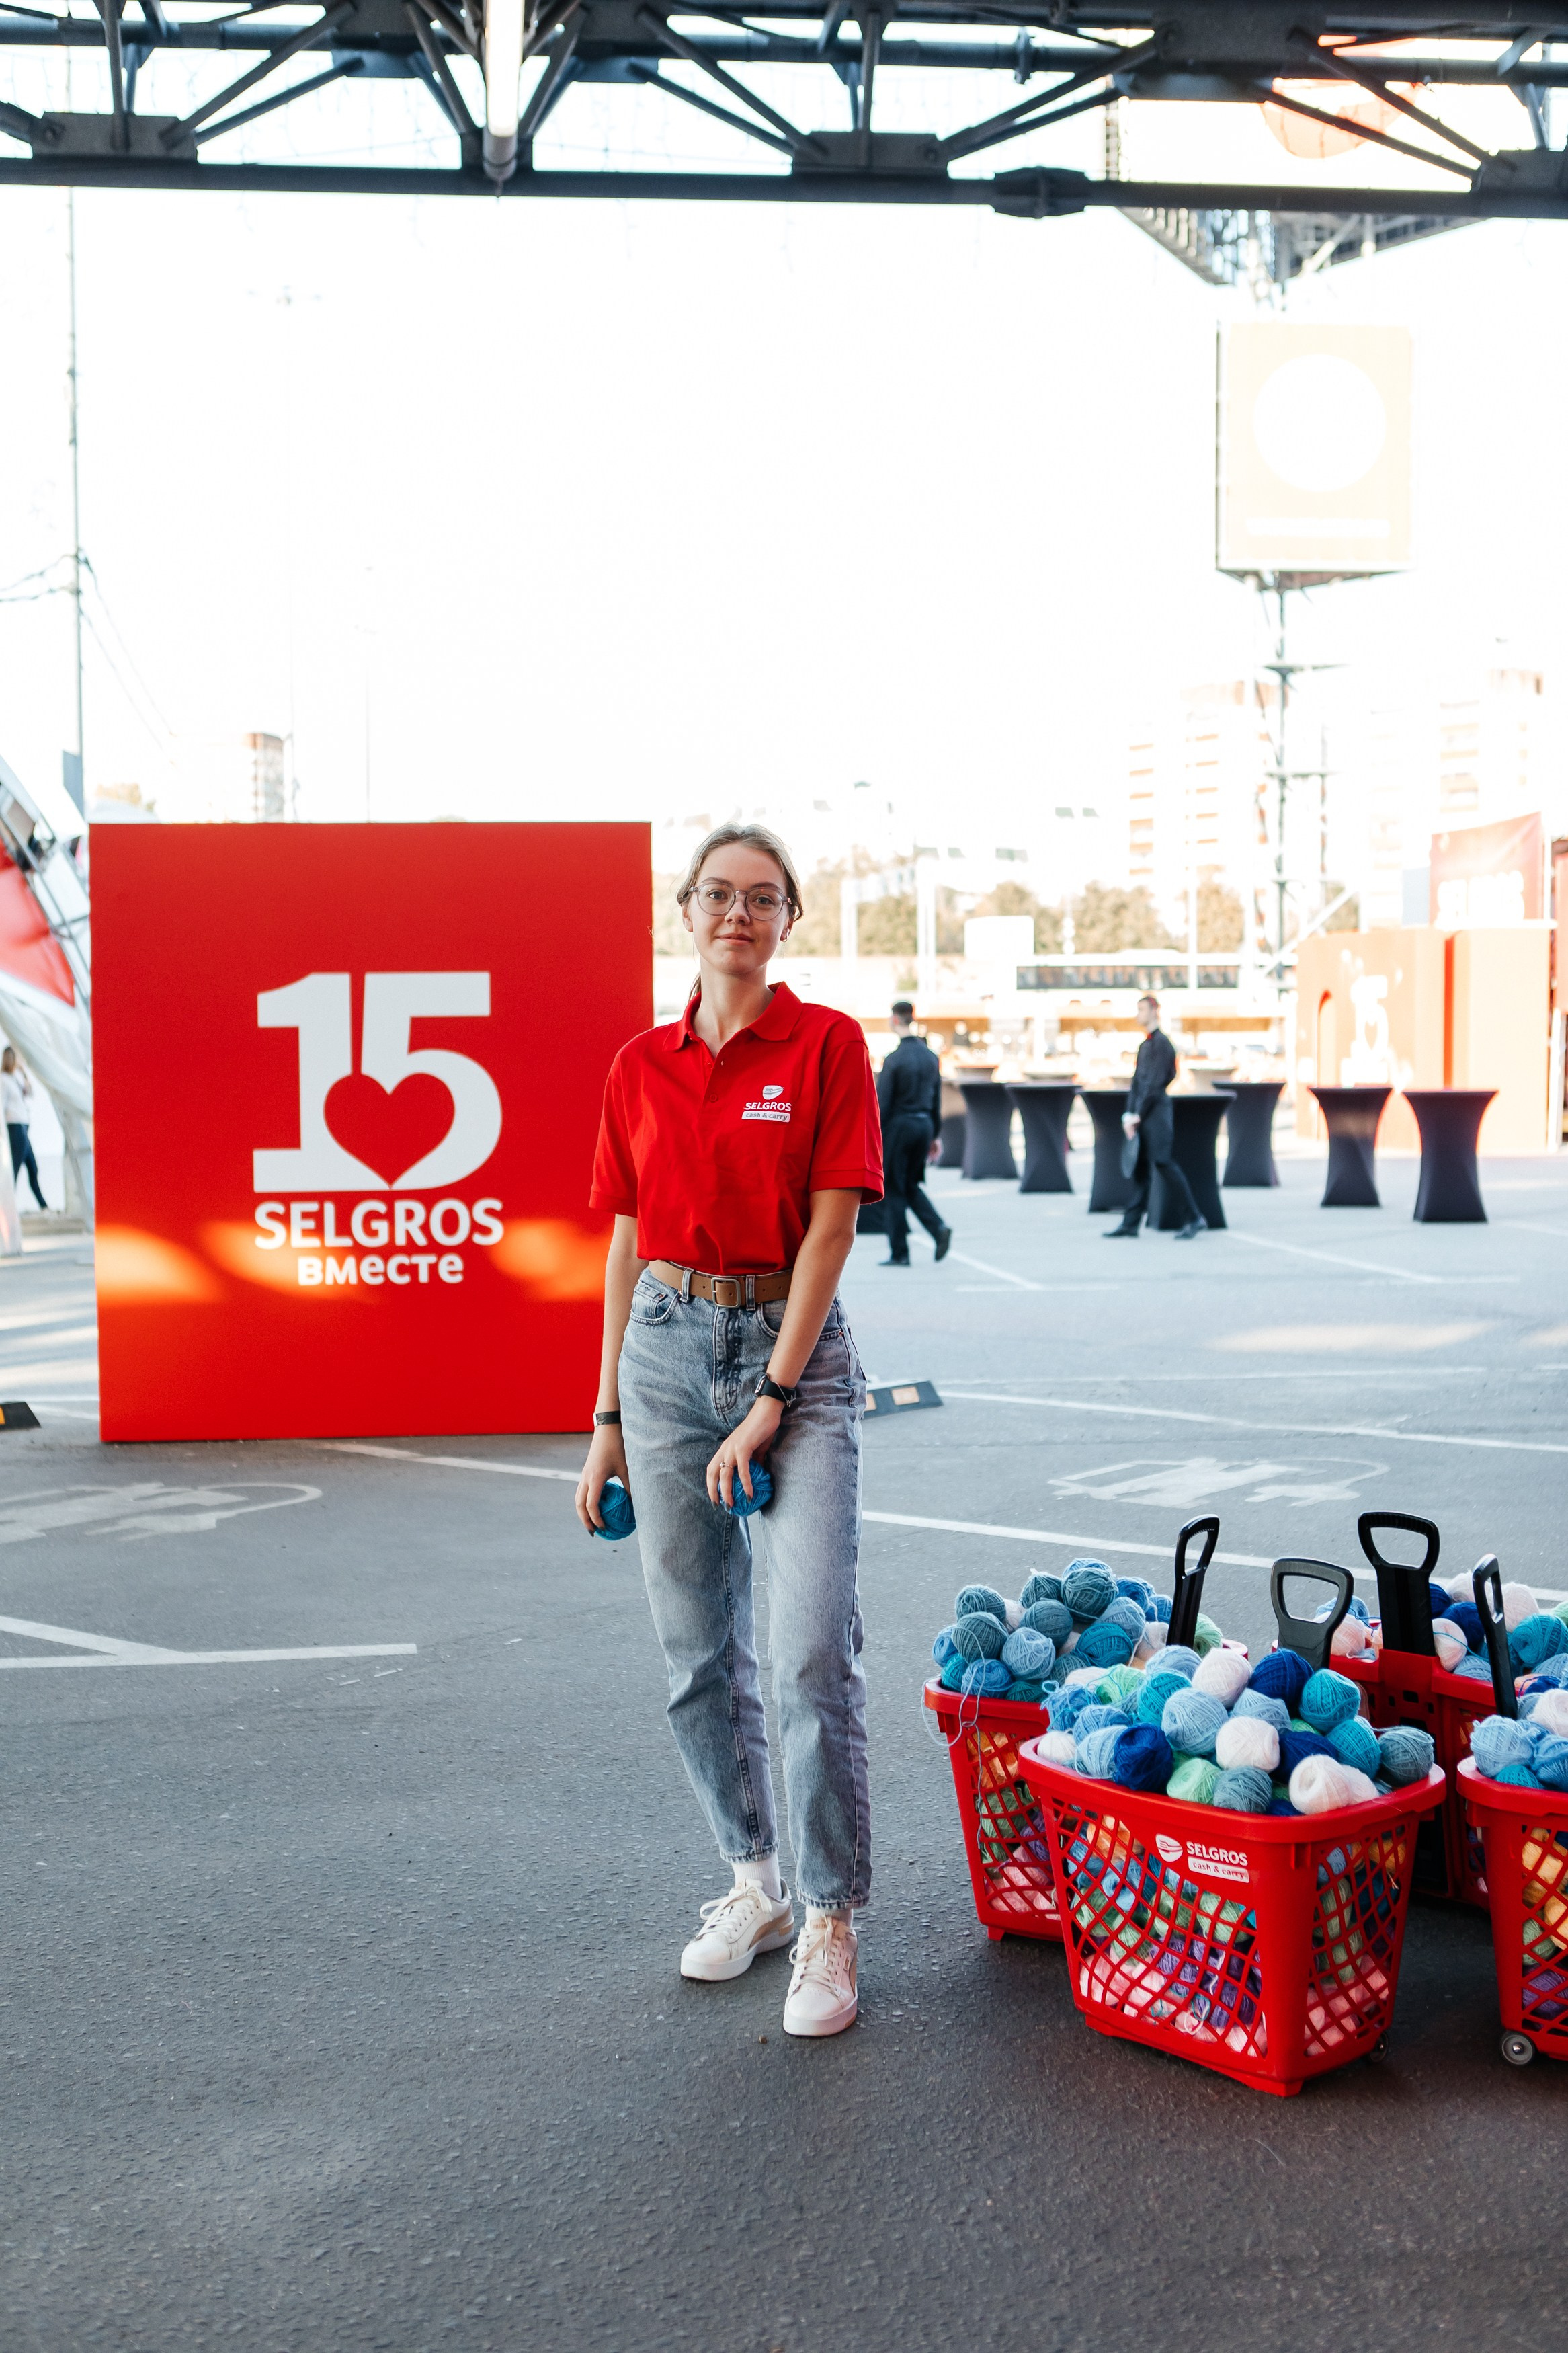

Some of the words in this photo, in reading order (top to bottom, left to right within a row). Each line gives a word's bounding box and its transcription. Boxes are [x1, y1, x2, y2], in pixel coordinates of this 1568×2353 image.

[253, 971, 502, 1193] 15
[744, 1102, 792, 1111] SELGROS
[254, 1199, 505, 1249] SELGROS
[1186, 1841, 1248, 1866] SELGROS
[1193, 1862, 1212, 1872] cash
[1213, 1865, 1221, 1874] &
[1222, 1868, 1245, 1880] carry
